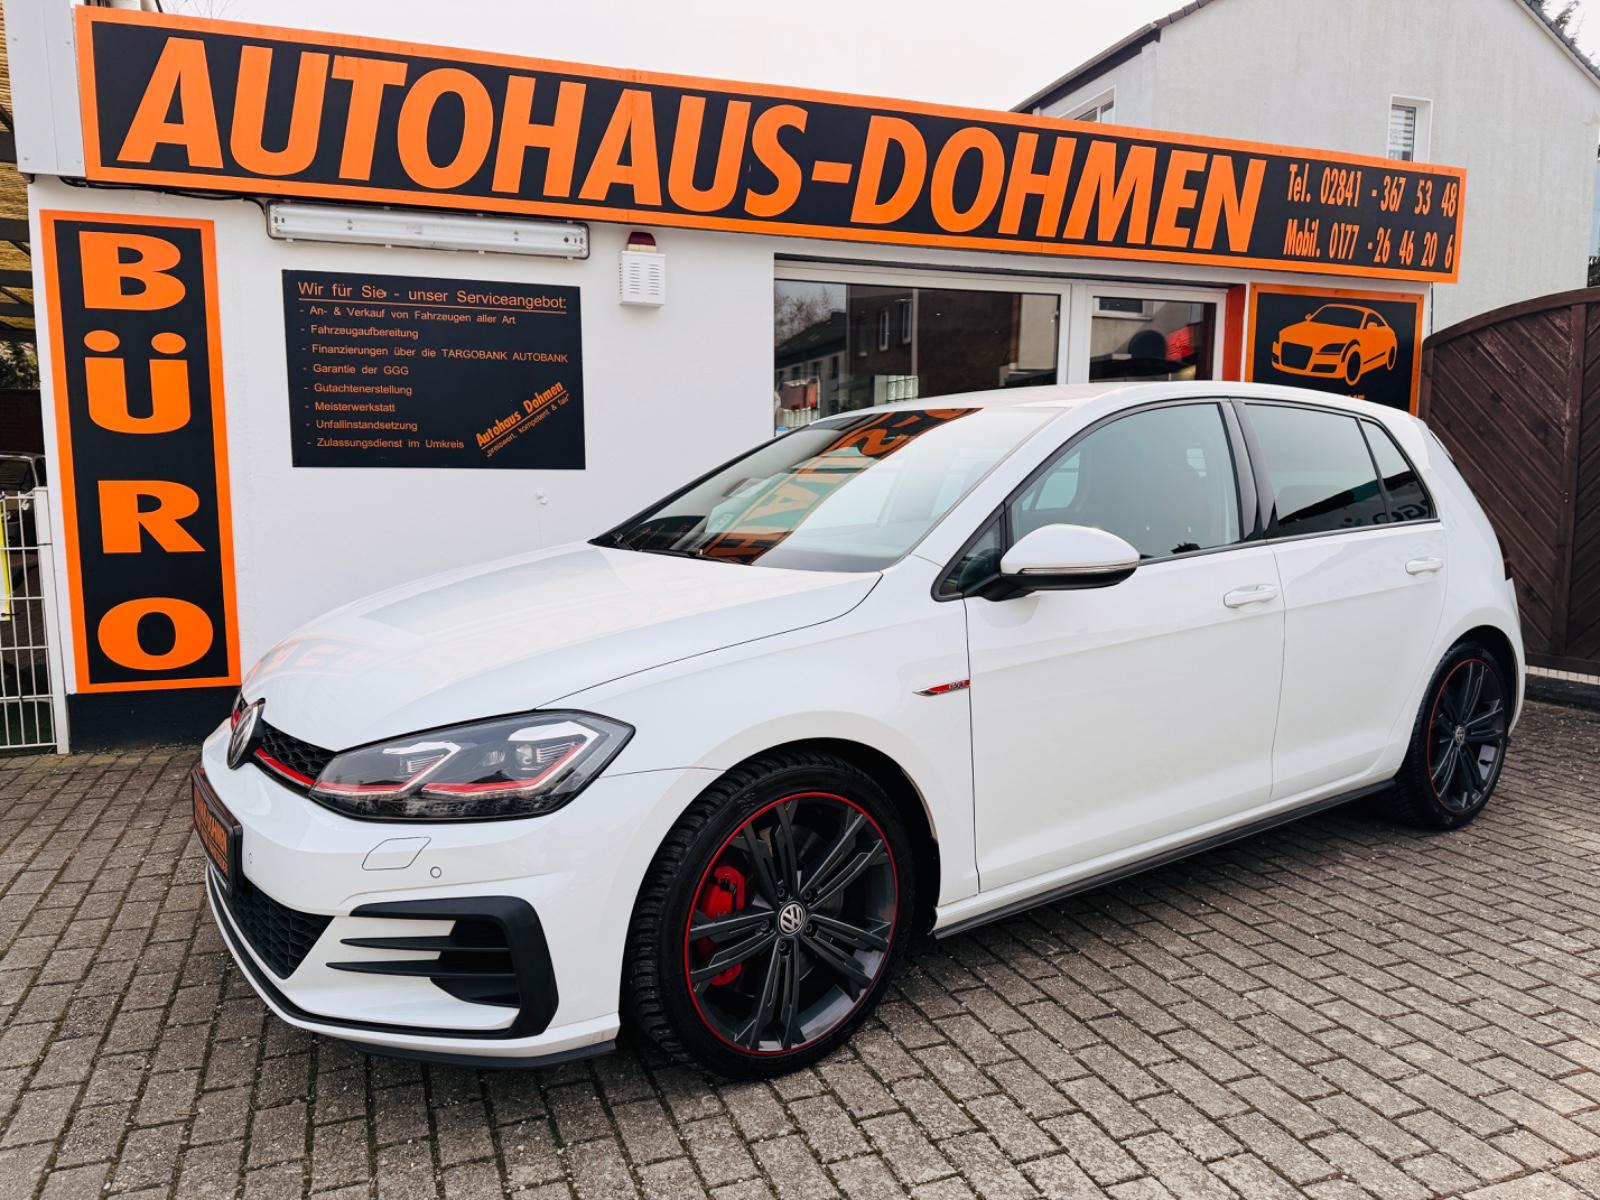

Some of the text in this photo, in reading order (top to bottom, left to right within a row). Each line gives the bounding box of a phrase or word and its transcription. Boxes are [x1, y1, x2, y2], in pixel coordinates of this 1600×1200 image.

[116, 36, 1267, 253] AUTOHAUS-DOHMEN
[1288, 163, 1311, 203] Tel.
[1320, 167, 1363, 208] 02841
[1414, 179, 1432, 215] 53
[1441, 182, 1458, 217] 48
[1283, 219, 1321, 258] Mobil.
[1329, 222, 1360, 260] 0177
[1399, 230, 1415, 266] 46
[1420, 231, 1438, 267] 20
[1444, 234, 1454, 269] 6
[298, 281, 324, 296] Wir
[332, 283, 352, 297] für
[408, 290, 449, 302] unser
[456, 289, 567, 309] Serviceangebot:
[309, 306, 517, 325] An- & Verkauf von Fahrzeugen aller Art
[310, 324, 419, 340] Fahrzeugaufbereitung
[311, 343, 568, 363] Finanzierungen über die TARGOBANK AUTOBANK
[313, 363, 409, 375] Garantie der GGG
[314, 382, 412, 397] Gutachtenerstellung
[315, 401, 396, 413] Meisterwerkstatt
[475, 381, 564, 447] Autohaus Dohmen
[316, 419, 418, 432] Unfallinstandsetzung
[78, 231, 214, 671] BÜRO
[316, 437, 464, 449] Zulassungsdienst im Umkreis
